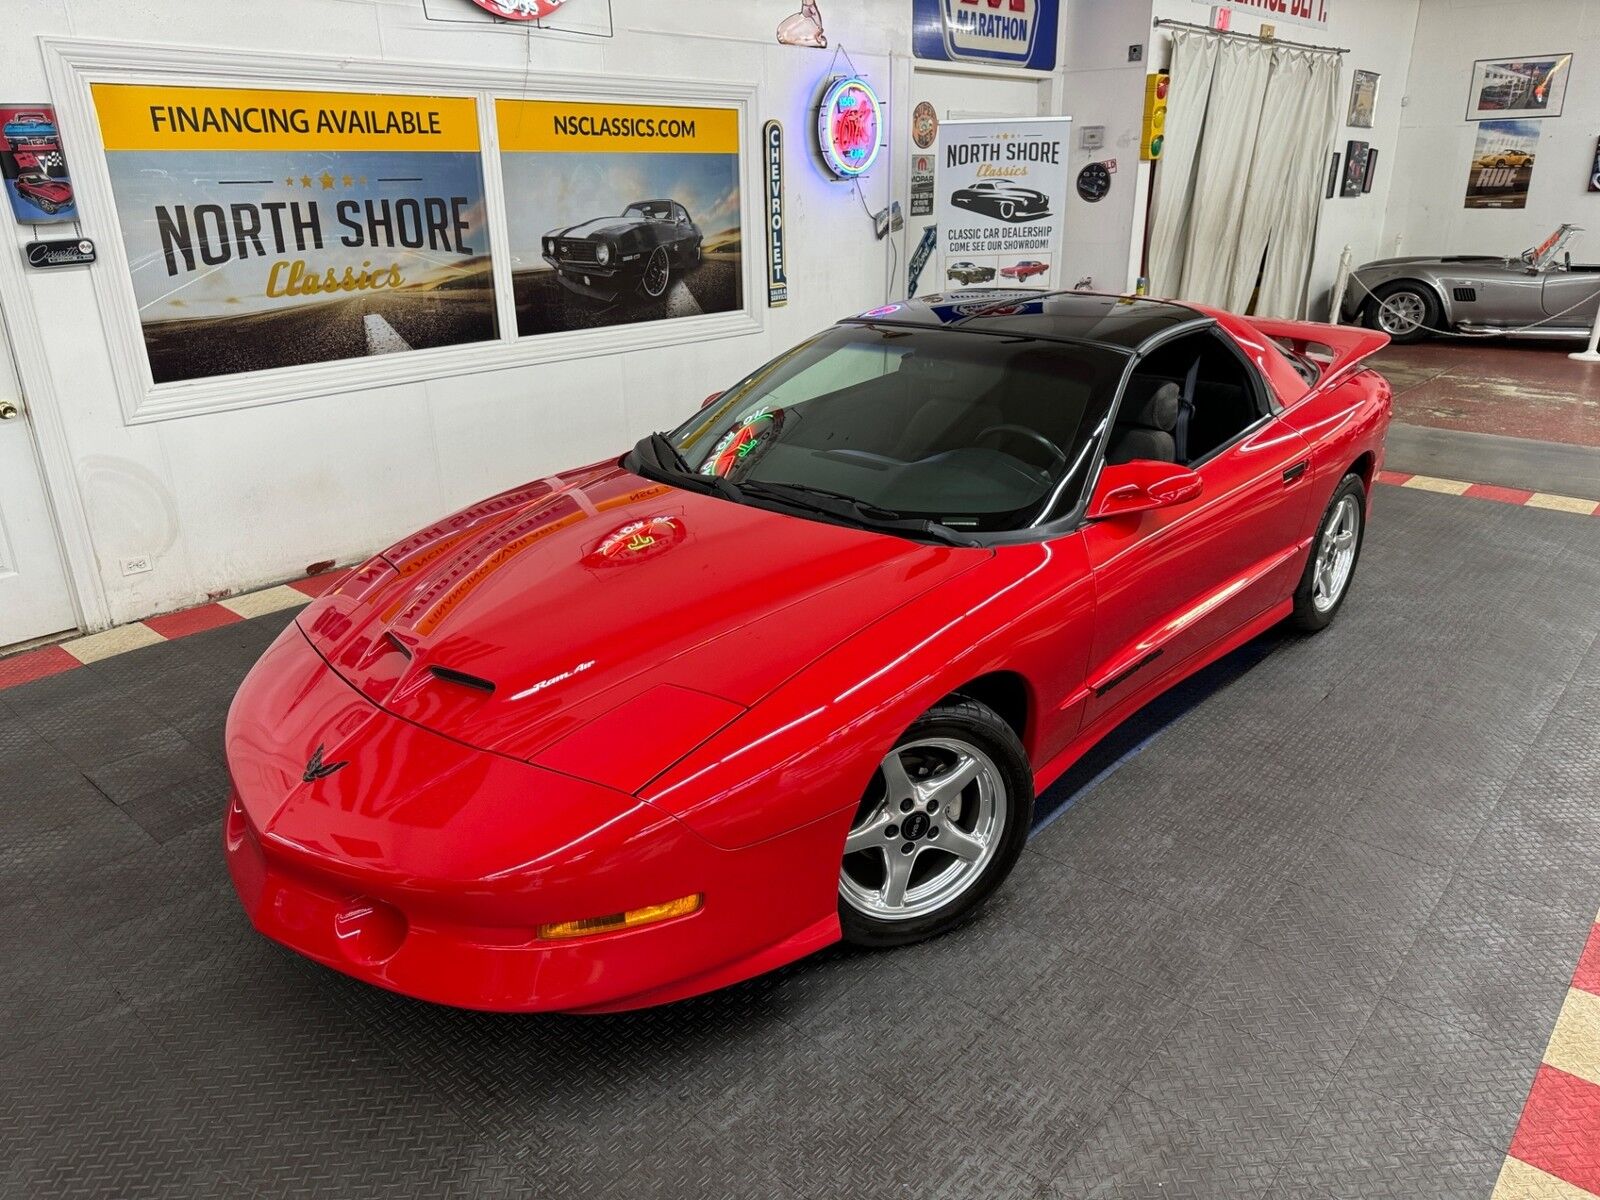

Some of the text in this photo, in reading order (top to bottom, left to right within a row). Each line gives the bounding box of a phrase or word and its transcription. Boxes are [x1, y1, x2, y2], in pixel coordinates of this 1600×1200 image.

[957, 10, 1028, 41] MARATHON
[150, 105, 442, 134] FINANCING AVAILABLE
[554, 115, 696, 138] NSCLASSICS.COM
[947, 142, 1060, 168] NORTH SHORE
[976, 163, 1028, 178] Classics
[1476, 168, 1519, 187] RIDE
[770, 130, 783, 280] CHEVROLET
[155, 197, 473, 277] NORTH SHORE
[948, 226, 1052, 240] CLASSIC CAR DEALERSHIP
[949, 239, 1049, 252] COME SEE OUR SHOWROOM!
[266, 260, 405, 299] Classics
[574, 660, 596, 674] Air
